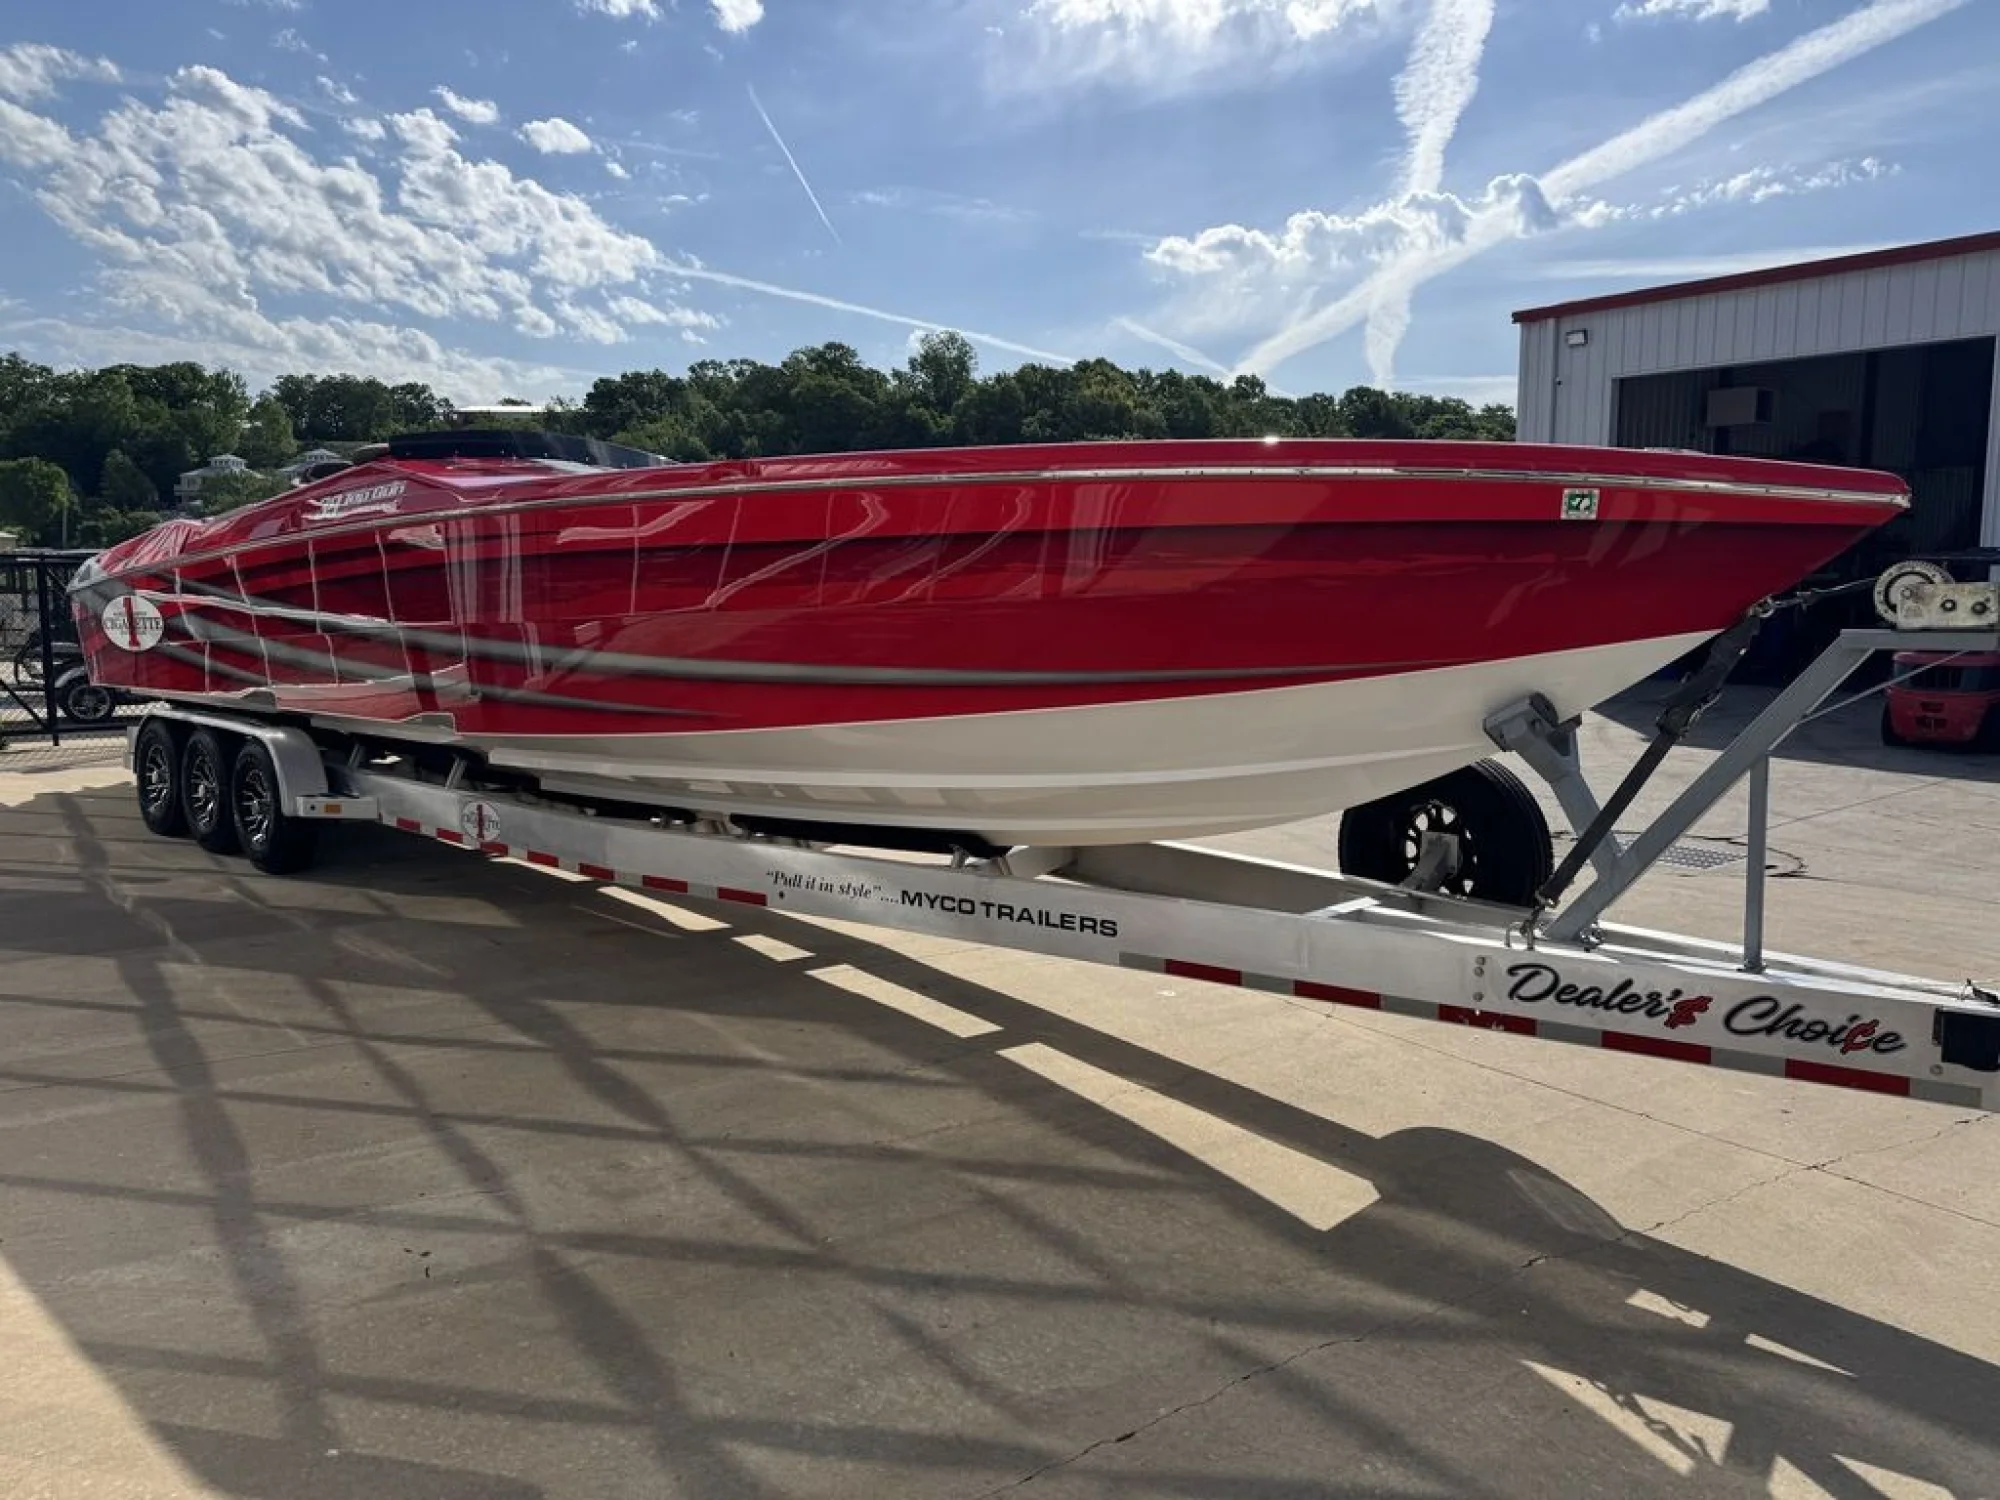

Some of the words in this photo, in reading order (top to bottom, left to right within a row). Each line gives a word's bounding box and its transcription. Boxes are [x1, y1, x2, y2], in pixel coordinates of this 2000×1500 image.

[103, 613, 163, 630] CIGAETTE
[806, 876, 816, 891] it
[819, 876, 835, 894] in
[901, 889, 976, 915] MYCO
[980, 901, 1119, 938] TRAILERS
